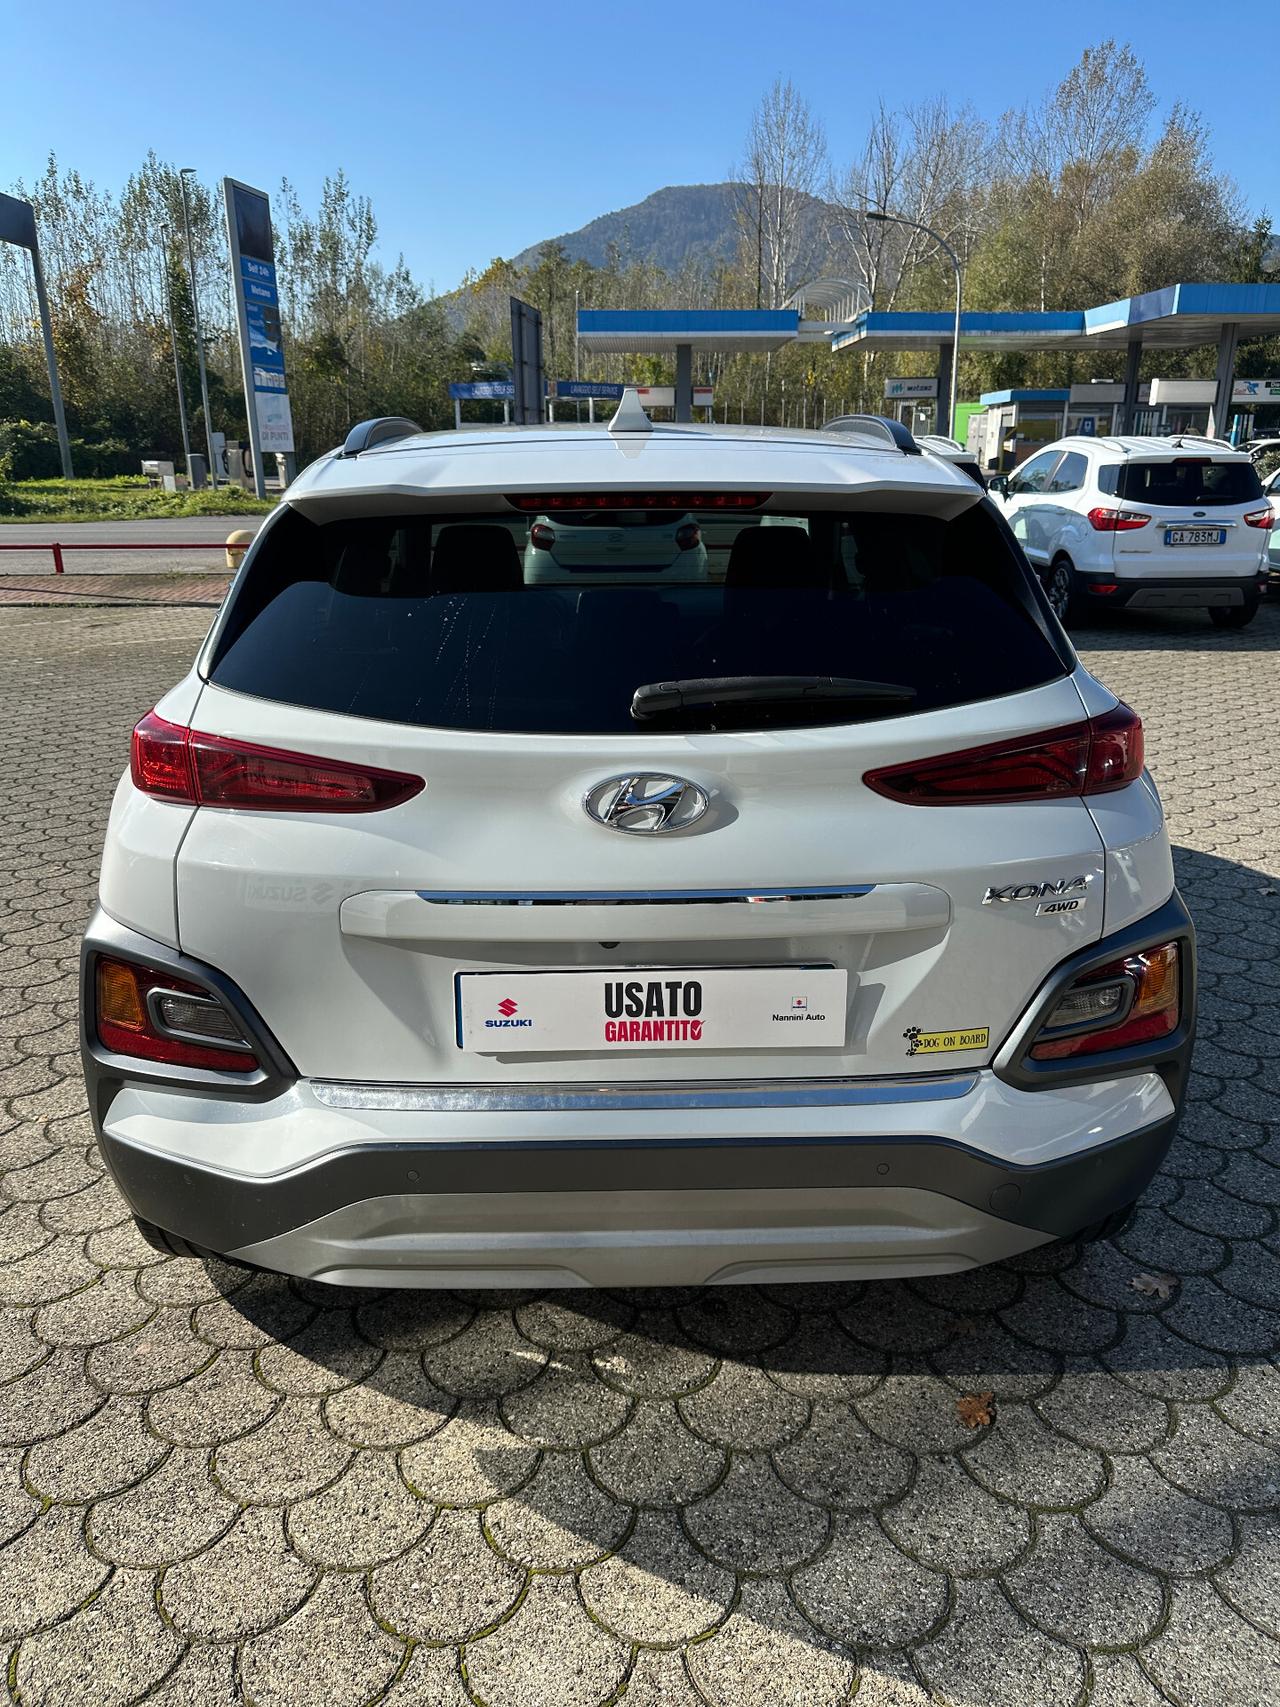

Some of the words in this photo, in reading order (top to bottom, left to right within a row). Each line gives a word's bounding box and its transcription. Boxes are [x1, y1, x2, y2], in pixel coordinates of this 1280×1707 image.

[1172, 531, 1185, 543] GA
[1188, 531, 1220, 543] 783MJ
[982, 875, 1094, 905] KONA
[1044, 901, 1079, 912] 4WD
[604, 981, 702, 1018] USATO
[485, 1019, 532, 1027] SUZUKI
[605, 1020, 704, 1042] GARANTITO
[924, 1038, 940, 1048] DOG
[943, 1037, 956, 1046] ON
[959, 1033, 986, 1045] BOARD
